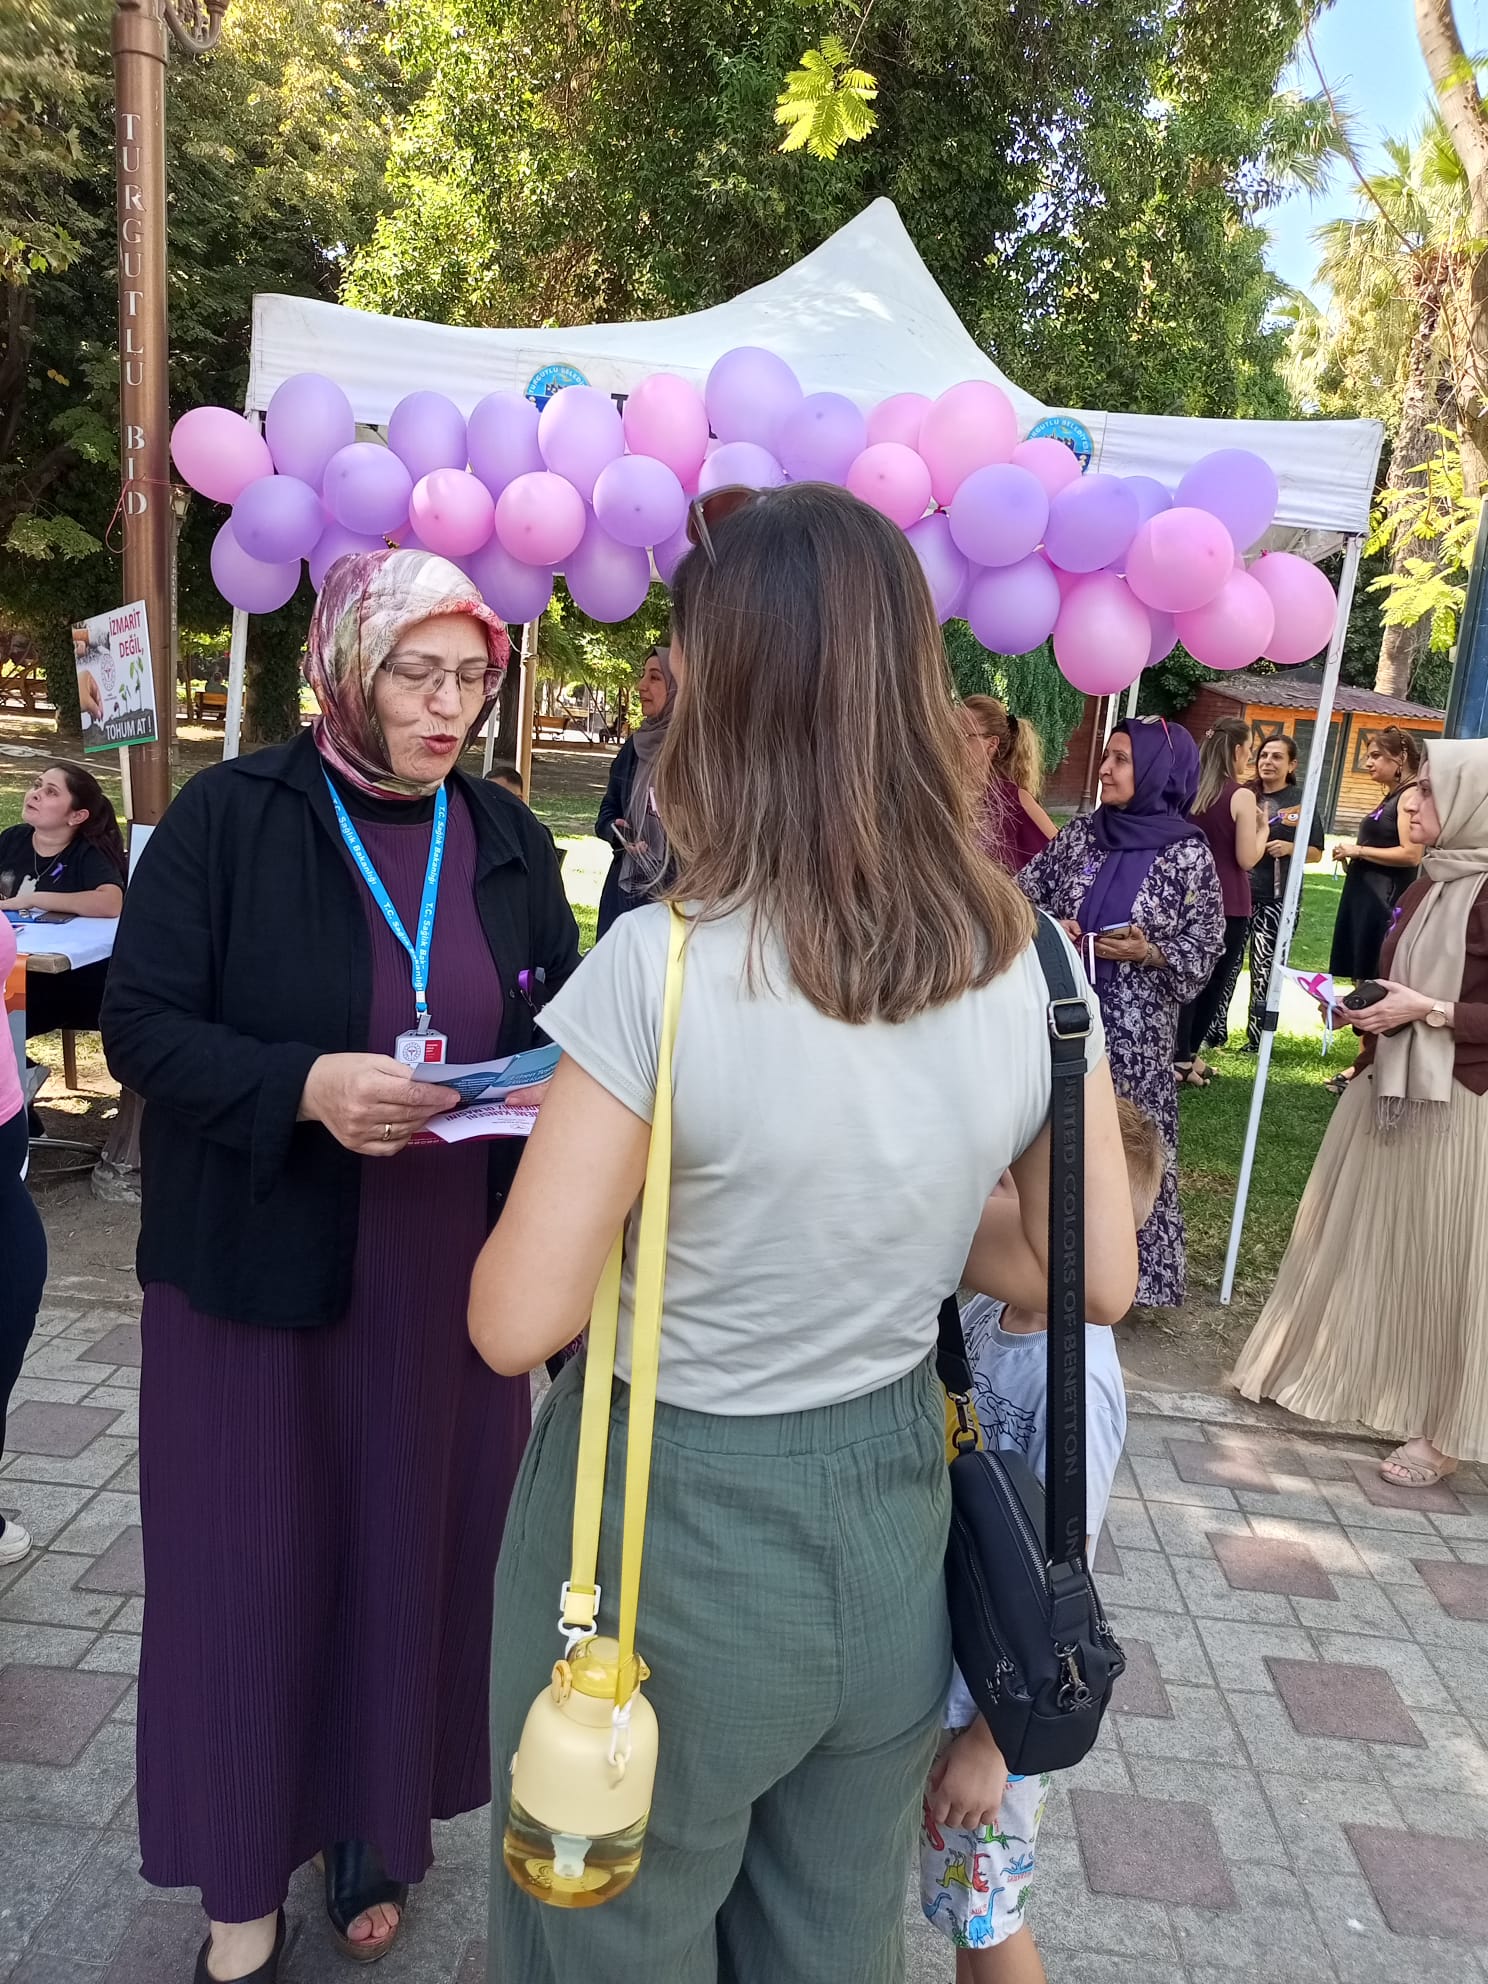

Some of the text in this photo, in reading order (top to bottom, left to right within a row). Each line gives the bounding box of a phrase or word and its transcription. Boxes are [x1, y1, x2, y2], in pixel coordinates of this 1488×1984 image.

[121, 112, 145, 388] TURGUTLU
[529, 367, 559, 393] TURGUTLU
[109, 608, 142, 637] İZMARİT
[119, 633, 144, 658] DEĞİL,
[105, 720, 136, 741] TOHUM
[136, 718, 147, 737] AT
[352, 844, 377, 885] Bakanlığı
[428, 846, 441, 885] Bakanlığı
[383, 901, 395, 920] T.C.
[424, 902, 434, 918] T.C.
[420, 919, 431, 947] Sağlık
[1063, 1172, 1077, 1284] COLORS
[1063, 1290, 1079, 1327] OF
